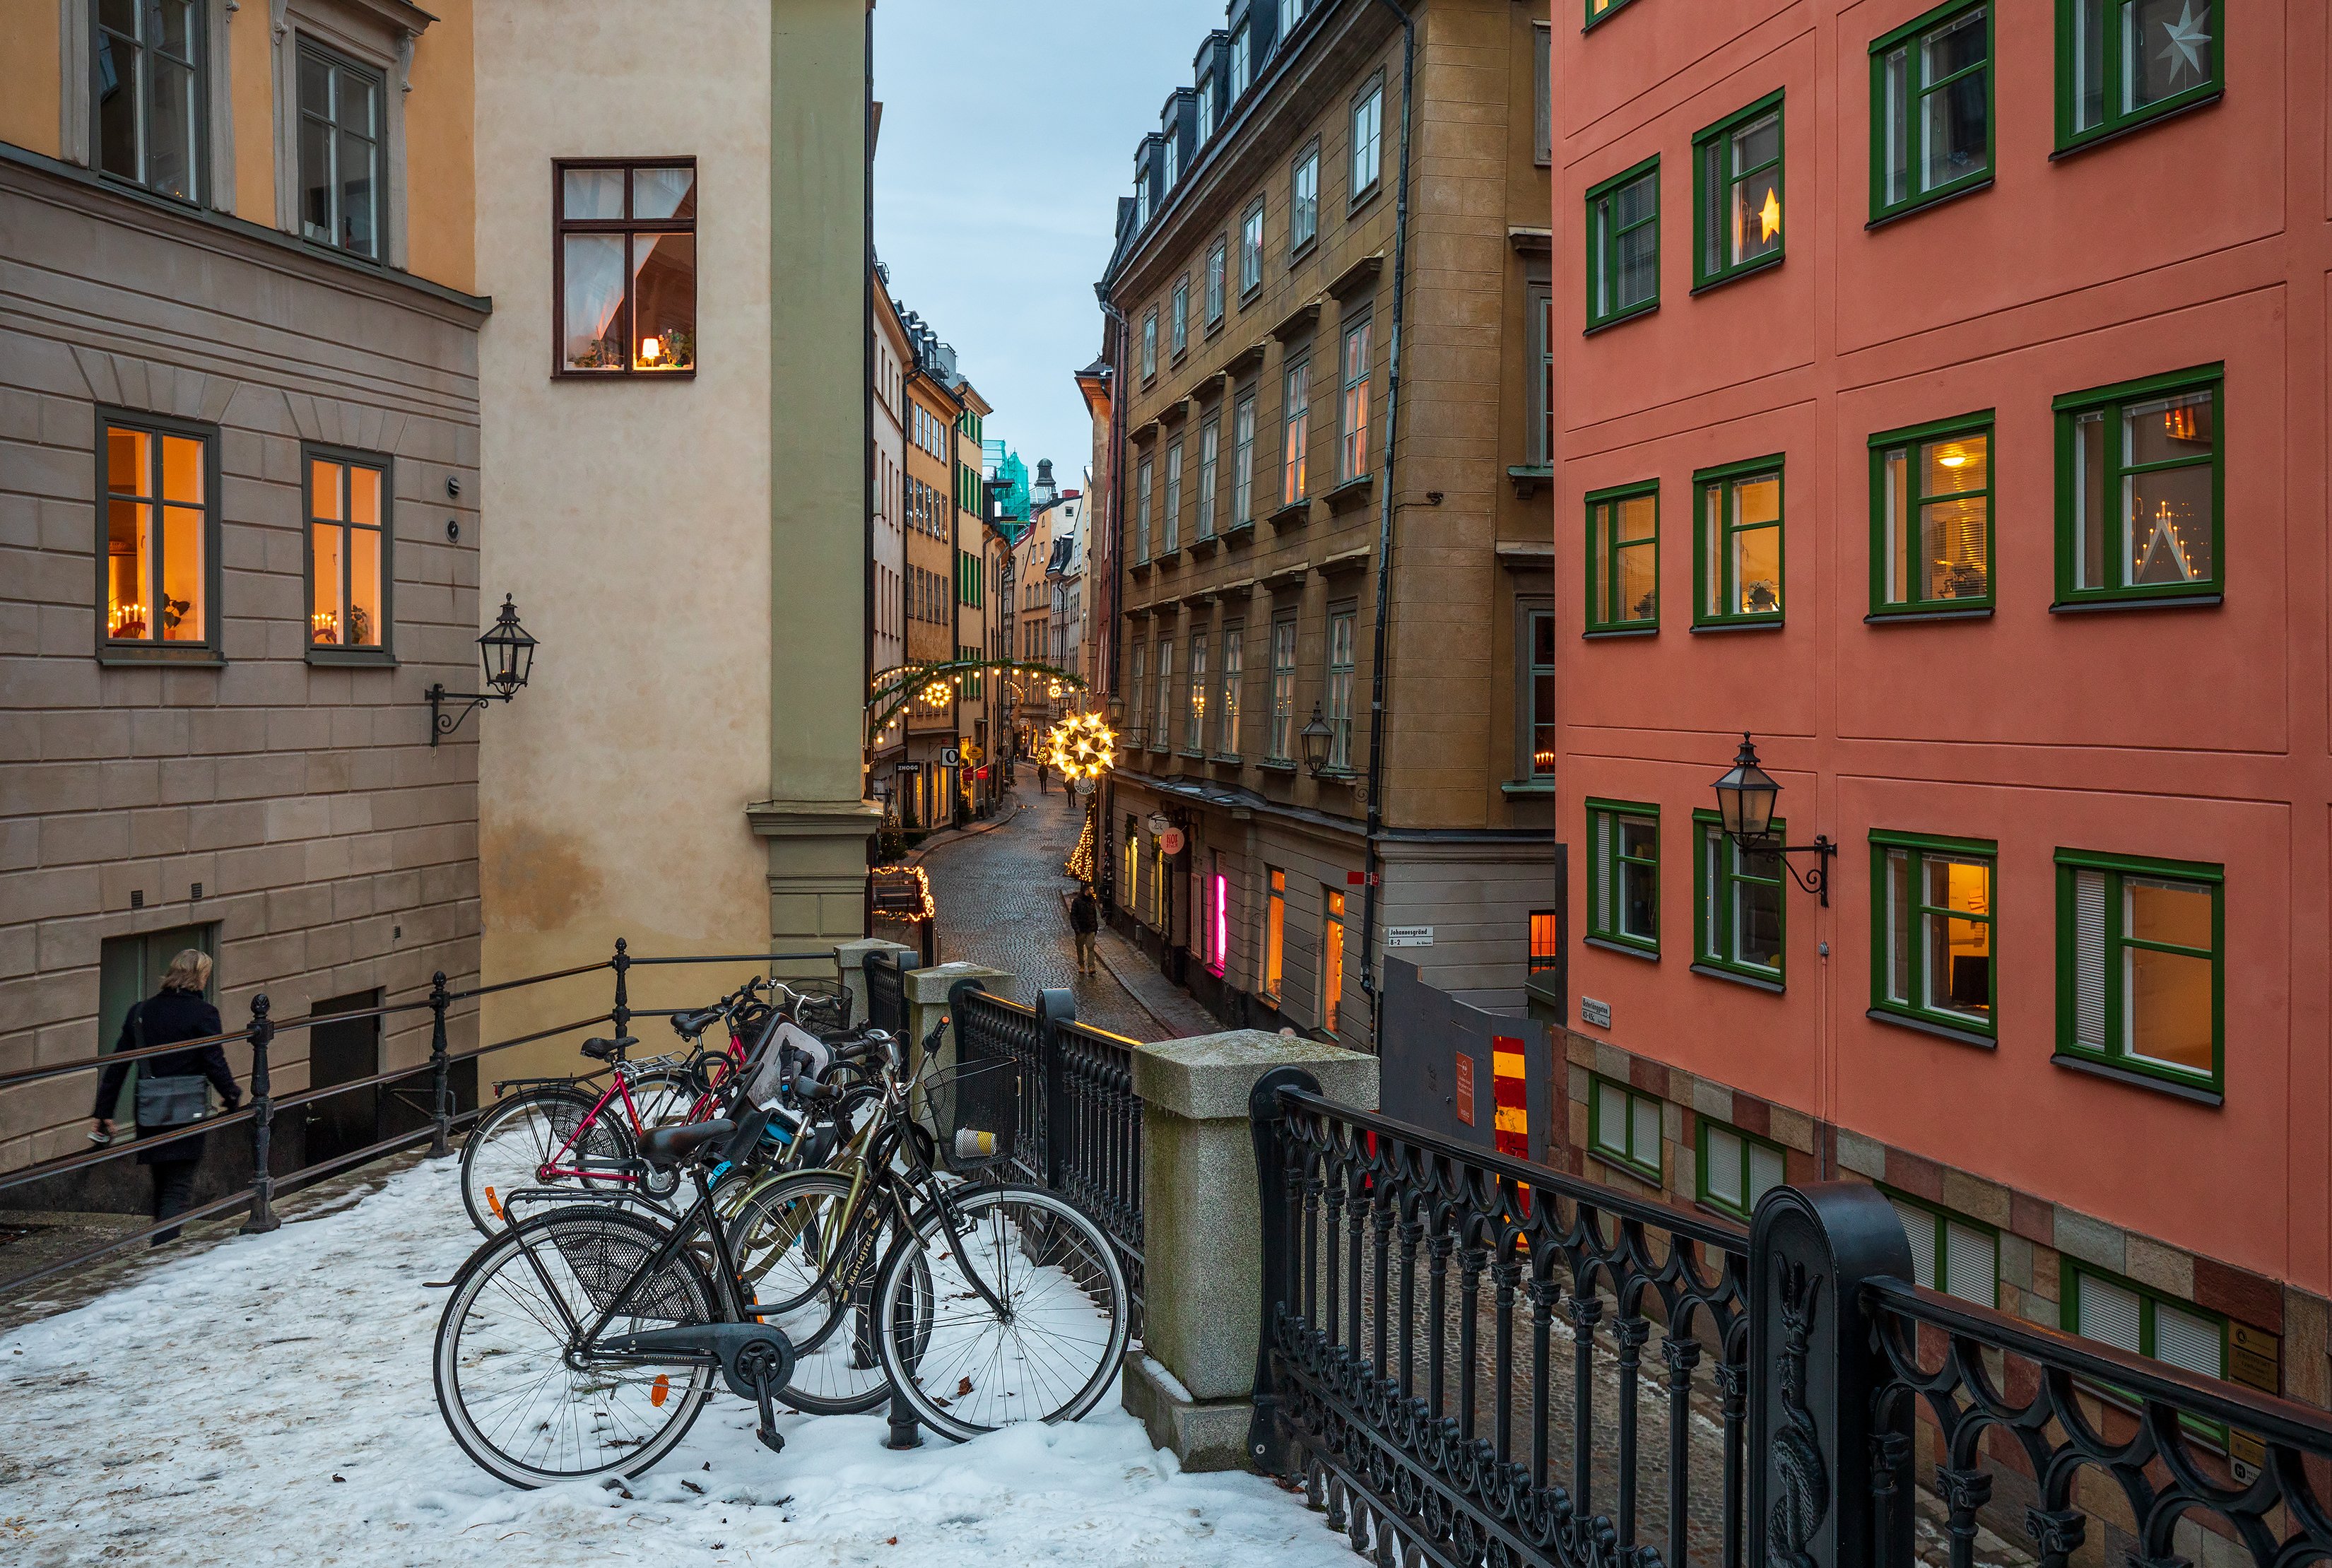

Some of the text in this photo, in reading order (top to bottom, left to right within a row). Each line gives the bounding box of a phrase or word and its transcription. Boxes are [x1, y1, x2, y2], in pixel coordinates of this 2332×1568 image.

[1166, 834, 1178, 844] KOI
[1583, 998, 1608, 1014] Österlånggatan
[847, 1233, 874, 1287] Mariefred
